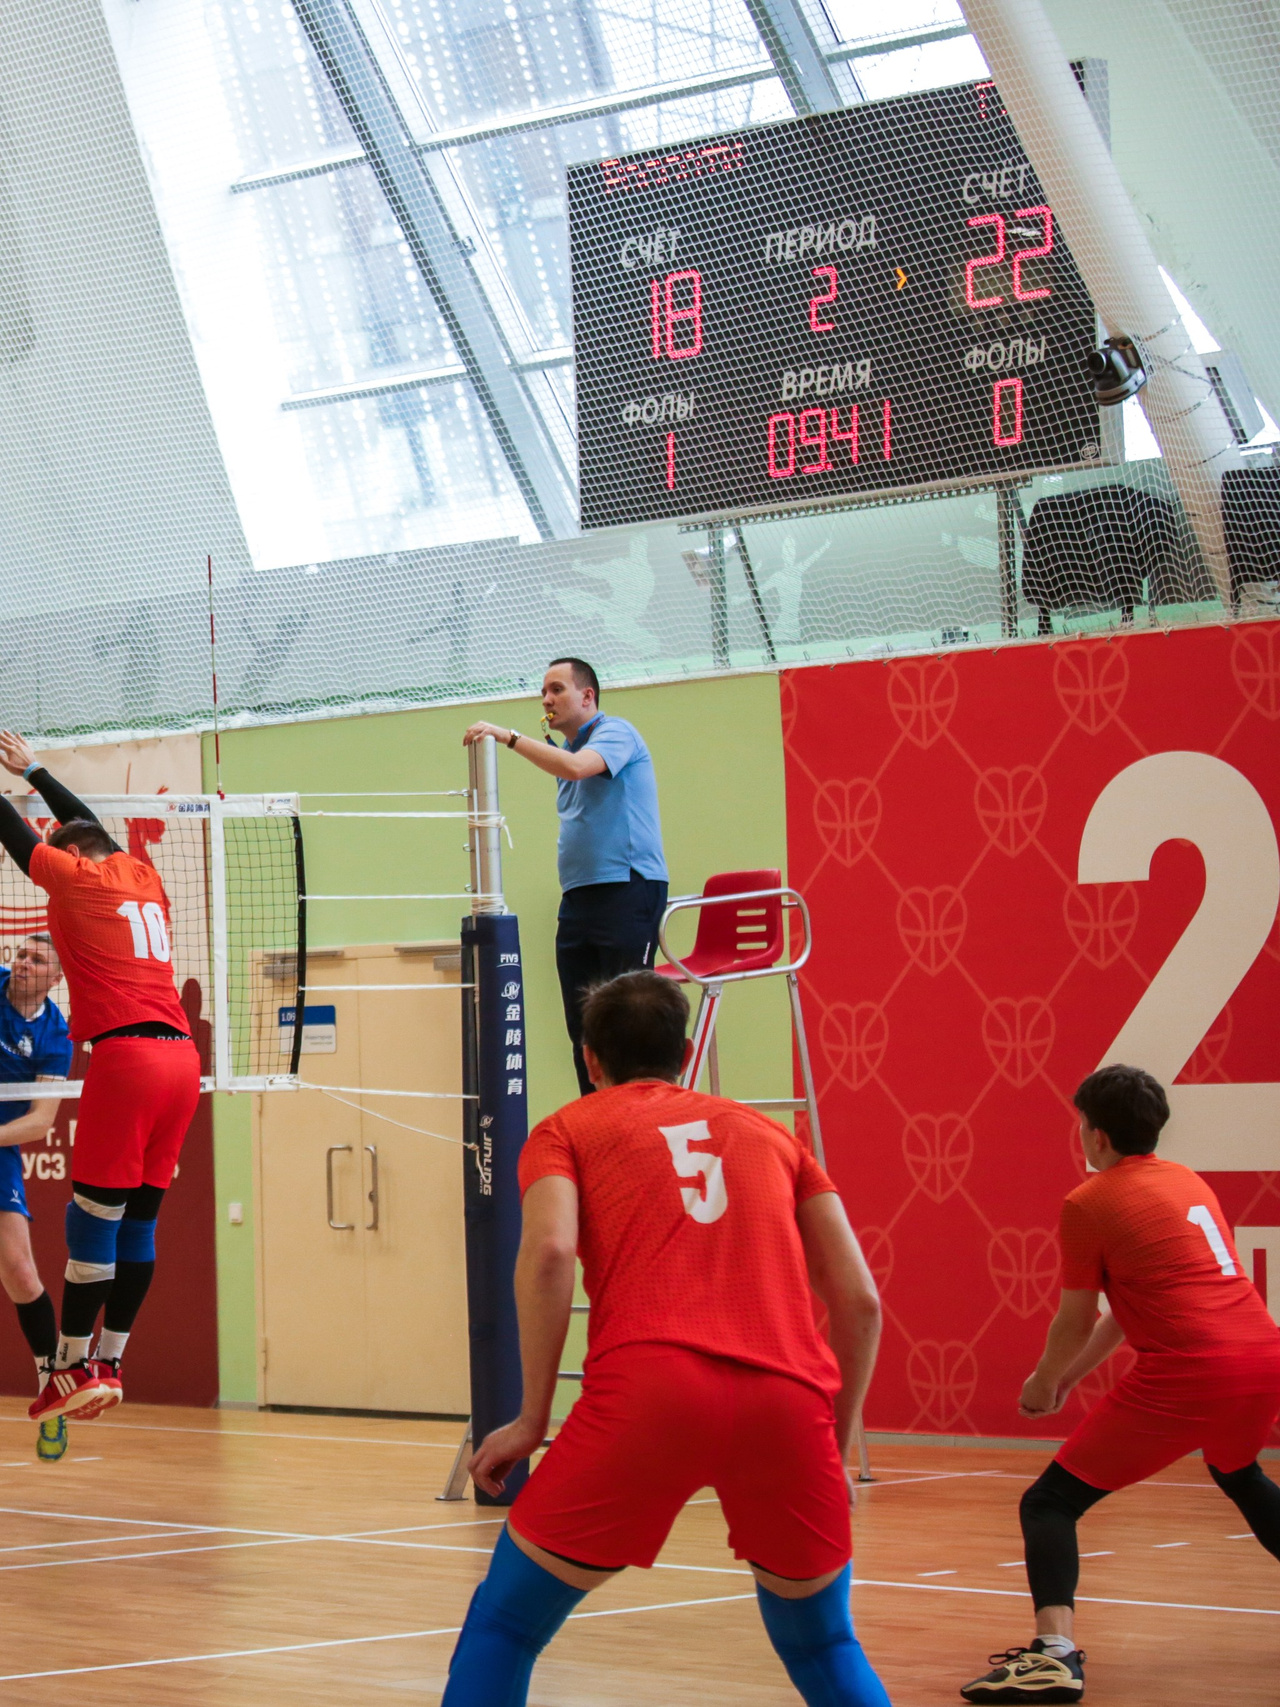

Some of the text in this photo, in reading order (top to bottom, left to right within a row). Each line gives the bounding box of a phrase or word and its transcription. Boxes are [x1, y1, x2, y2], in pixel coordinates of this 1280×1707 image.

[963, 160, 1030, 204] СЧЁТ
[621, 226, 681, 268] СЧЁТ
[766, 215, 877, 264] ПЕРИОД
[966, 205, 1053, 308] 22
[651, 269, 702, 359] 18
[810, 265, 837, 331] 2
[782, 358, 871, 401] ВРЕМЯ
[964, 335, 1047, 374] ФОЛЫ
[621, 391, 694, 428] ФОЛЫ
[993, 377, 1023, 446] 0
[666, 431, 675, 490] 1
[116, 901, 170, 963] 10
[1078, 750, 1280, 1171] 2
[505, 1004, 523, 1096] 金陵体育
[658, 1119, 728, 1224] 5
[1186, 1205, 1237, 1276] 1
